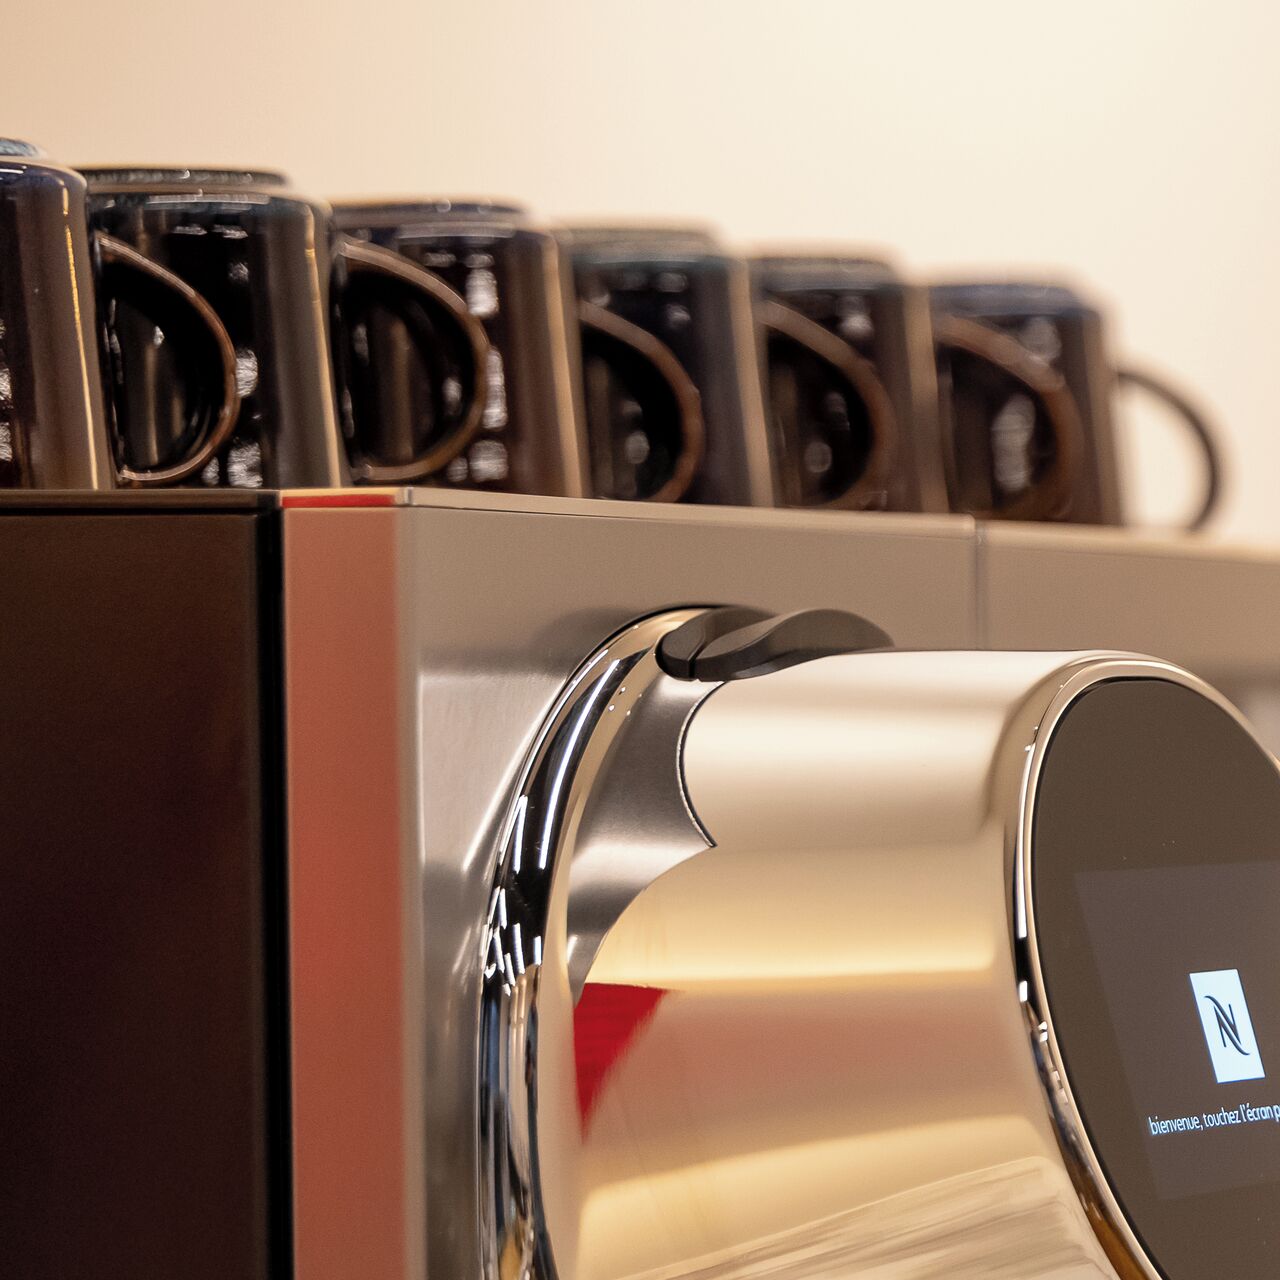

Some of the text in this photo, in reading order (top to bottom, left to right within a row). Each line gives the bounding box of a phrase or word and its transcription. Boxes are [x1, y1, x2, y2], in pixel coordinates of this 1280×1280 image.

[1148, 1116, 1204, 1135] bienvenue,
[1202, 1106, 1241, 1128] touchez
[1240, 1102, 1274, 1122] l'écran
